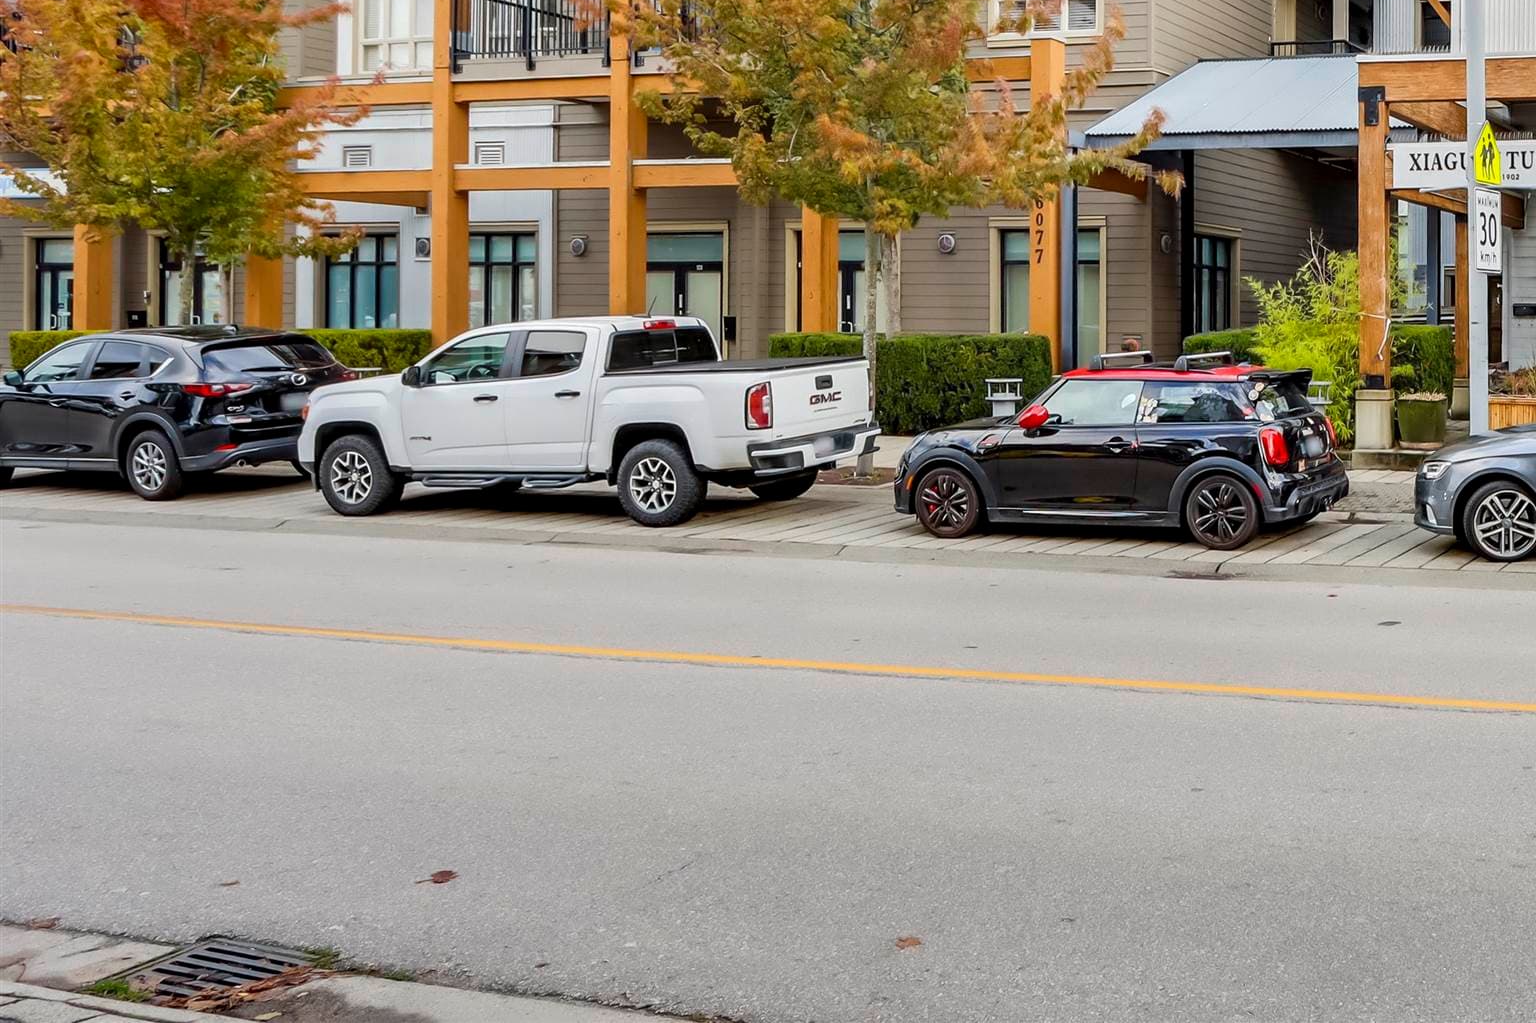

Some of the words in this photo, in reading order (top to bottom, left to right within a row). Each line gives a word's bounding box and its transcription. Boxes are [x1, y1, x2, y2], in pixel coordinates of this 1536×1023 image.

[1034, 194, 1044, 264] 6077
[1479, 212, 1497, 247] 30
[810, 391, 842, 405] GMC
